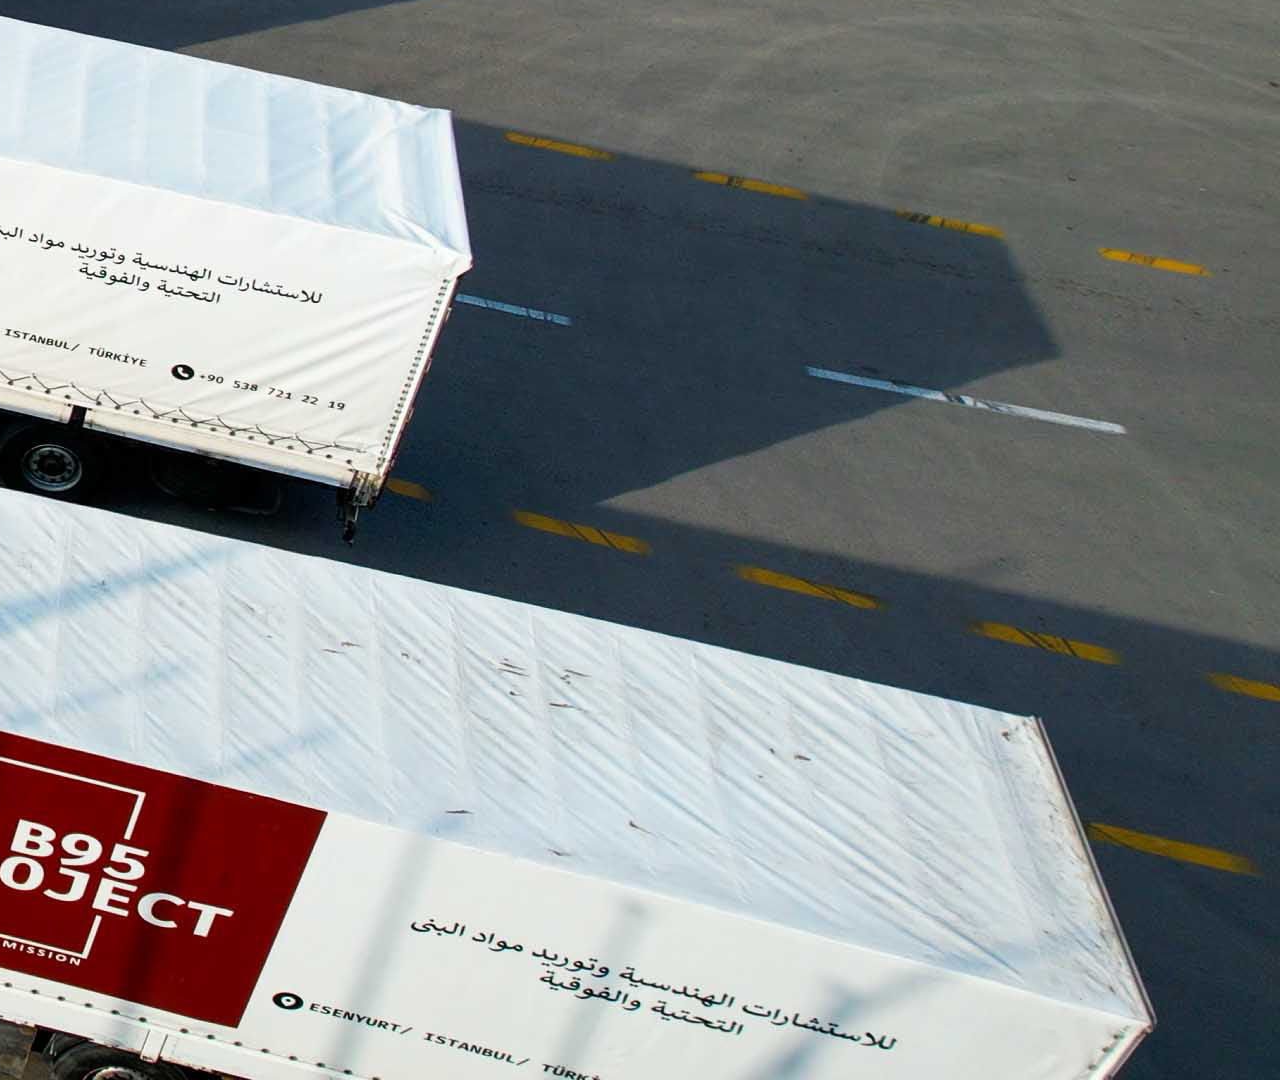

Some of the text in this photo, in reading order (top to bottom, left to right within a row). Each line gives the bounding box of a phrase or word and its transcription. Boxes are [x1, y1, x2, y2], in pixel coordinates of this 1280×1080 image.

[28, 234, 65, 250] مواد
[70, 243, 125, 265] وتوريد
[132, 253, 212, 281] الهندسية
[79, 262, 221, 305] التحتية والفوقية
[217, 275, 323, 304] للاستشارات
[88, 347, 148, 368] TÜRKİYE
[199, 372, 346, 411] +90 538 721 22 19
[10, 819, 149, 880] B95
[2, 940, 81, 966] MISSION
[411, 917, 896, 1051] للاستشارات الهندسية وتوريد مواد البنى
[539, 970, 743, 1036] التحتية والفوقية
[310, 1003, 413, 1035] ESENYURT/
